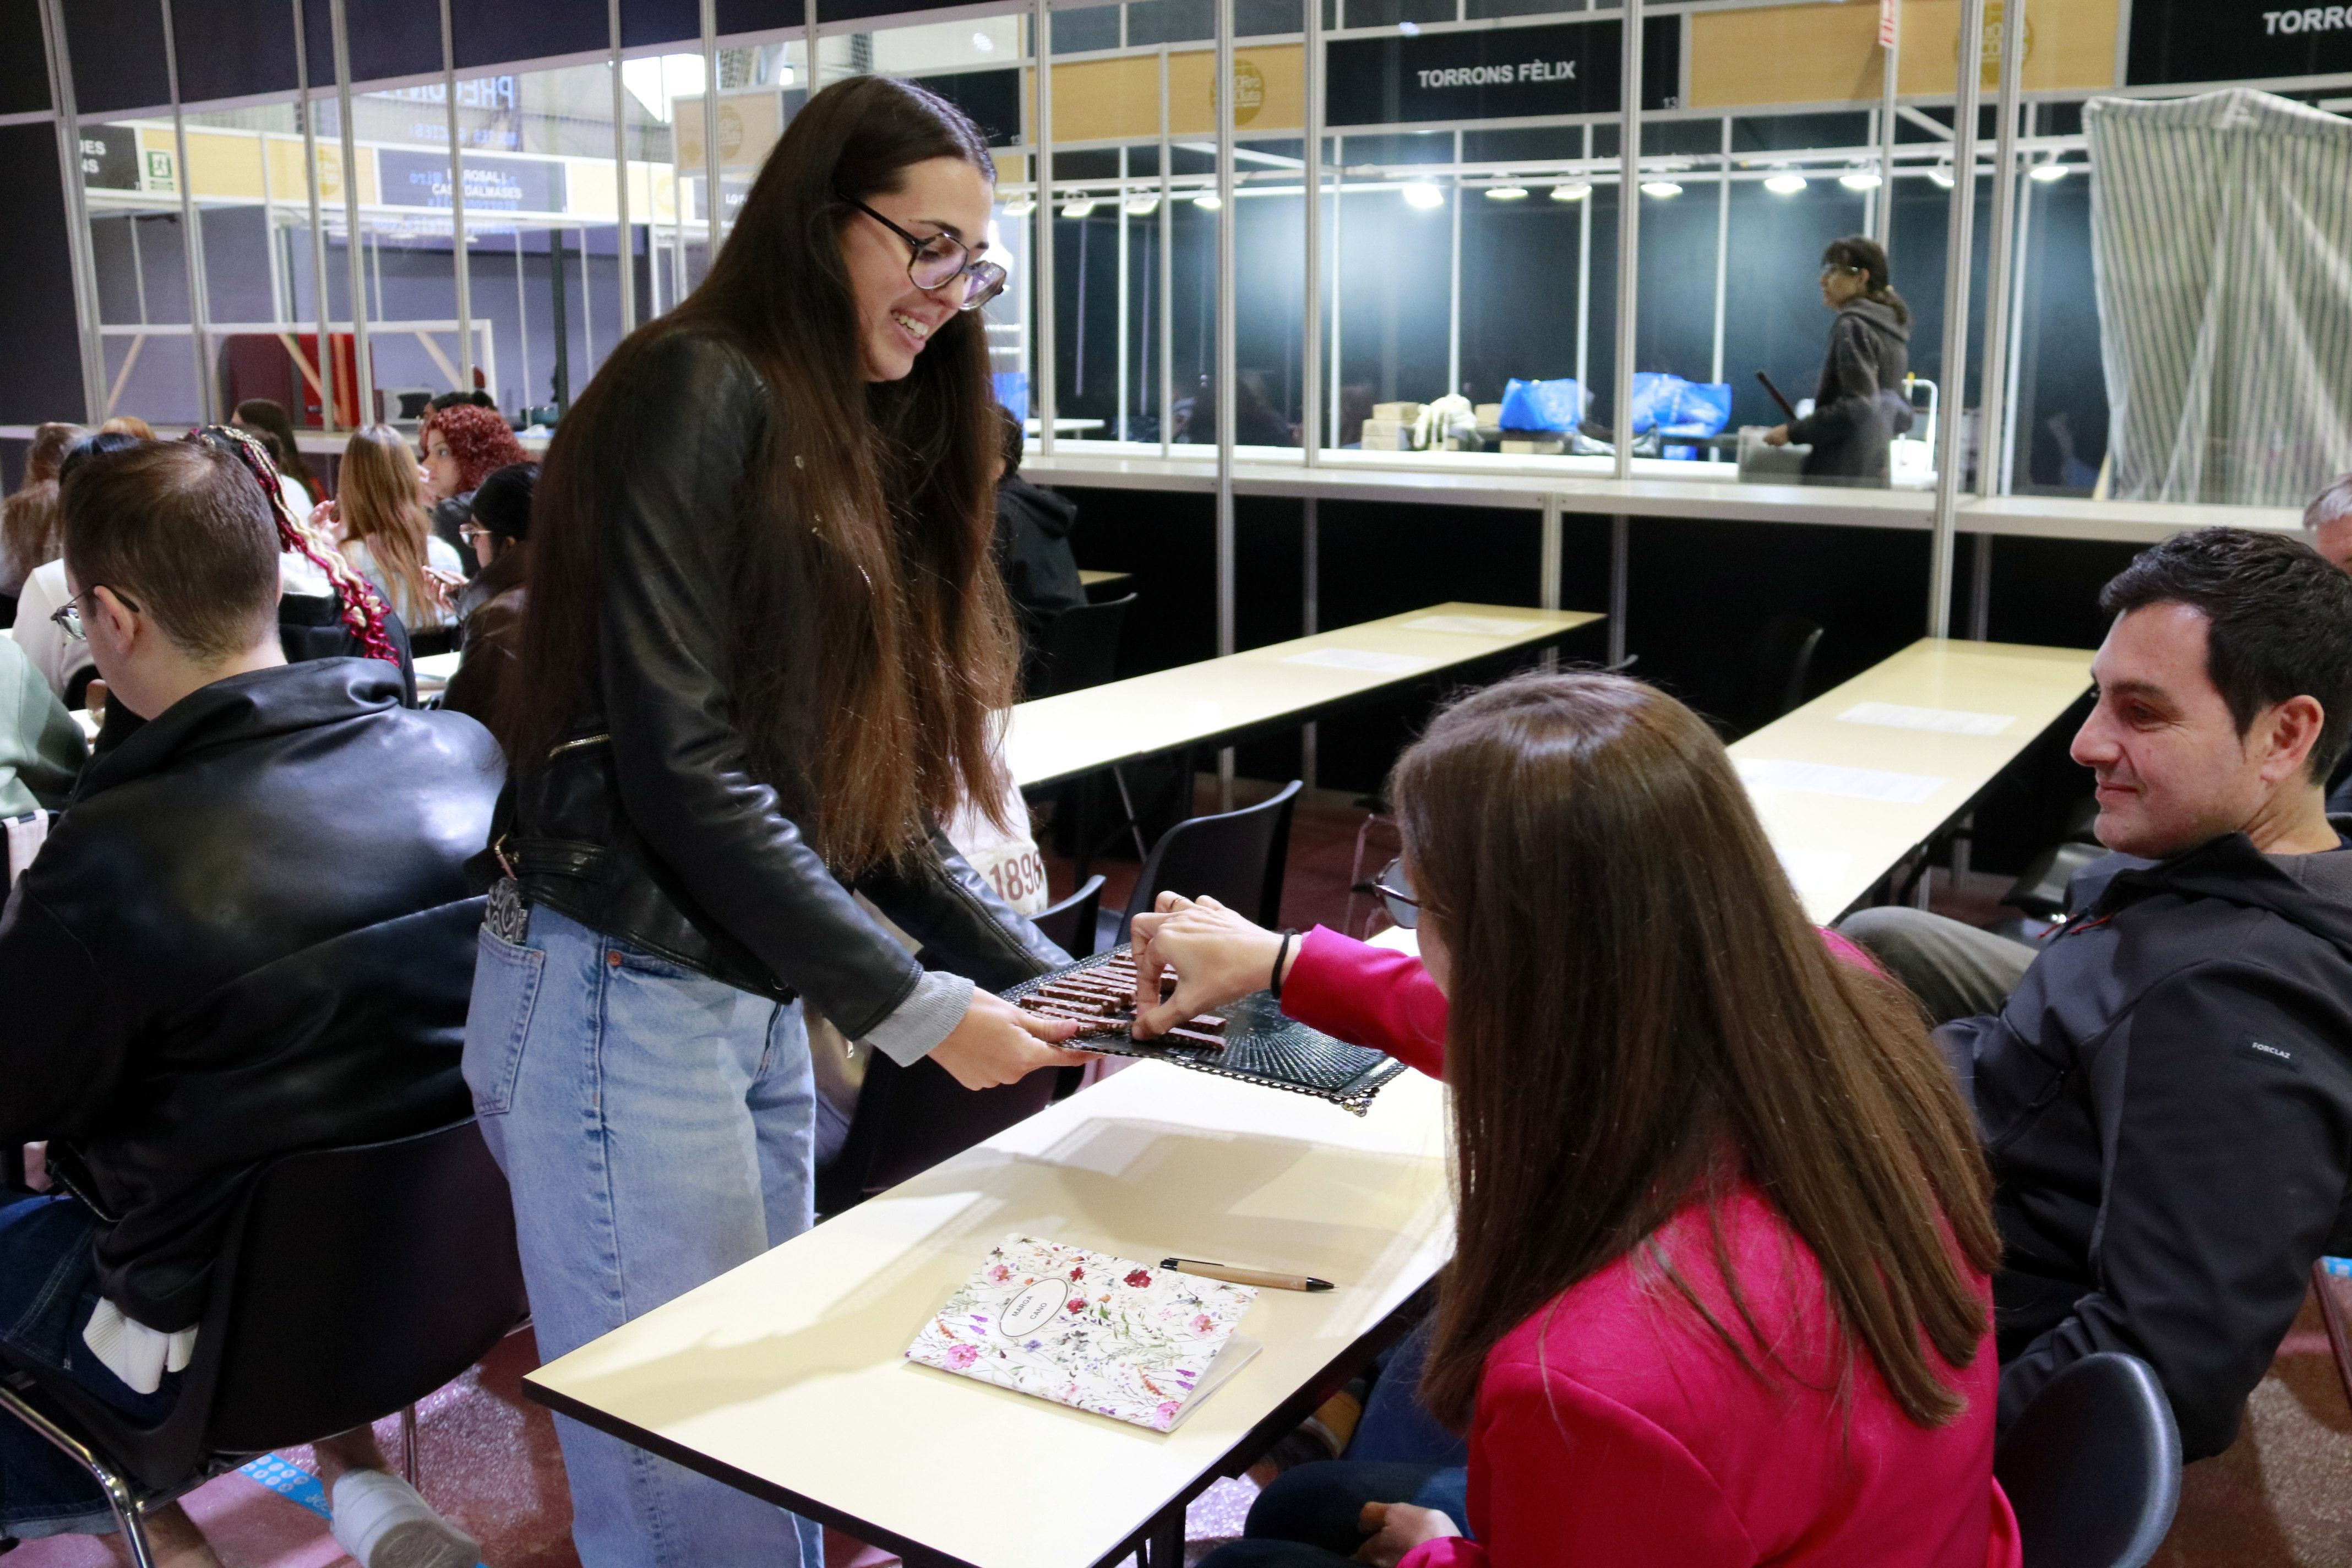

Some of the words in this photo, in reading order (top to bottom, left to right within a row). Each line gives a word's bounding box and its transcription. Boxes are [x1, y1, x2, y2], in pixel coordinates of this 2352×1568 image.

[1417, 64, 1514, 88] TORRONS
[1518, 58, 1576, 82] FÈLIX
[2252, 1042, 2291, 1059] FORCLAZ
[1011, 1295, 1033, 1317] MARGA
[1029, 1302, 1047, 1320] CANO
